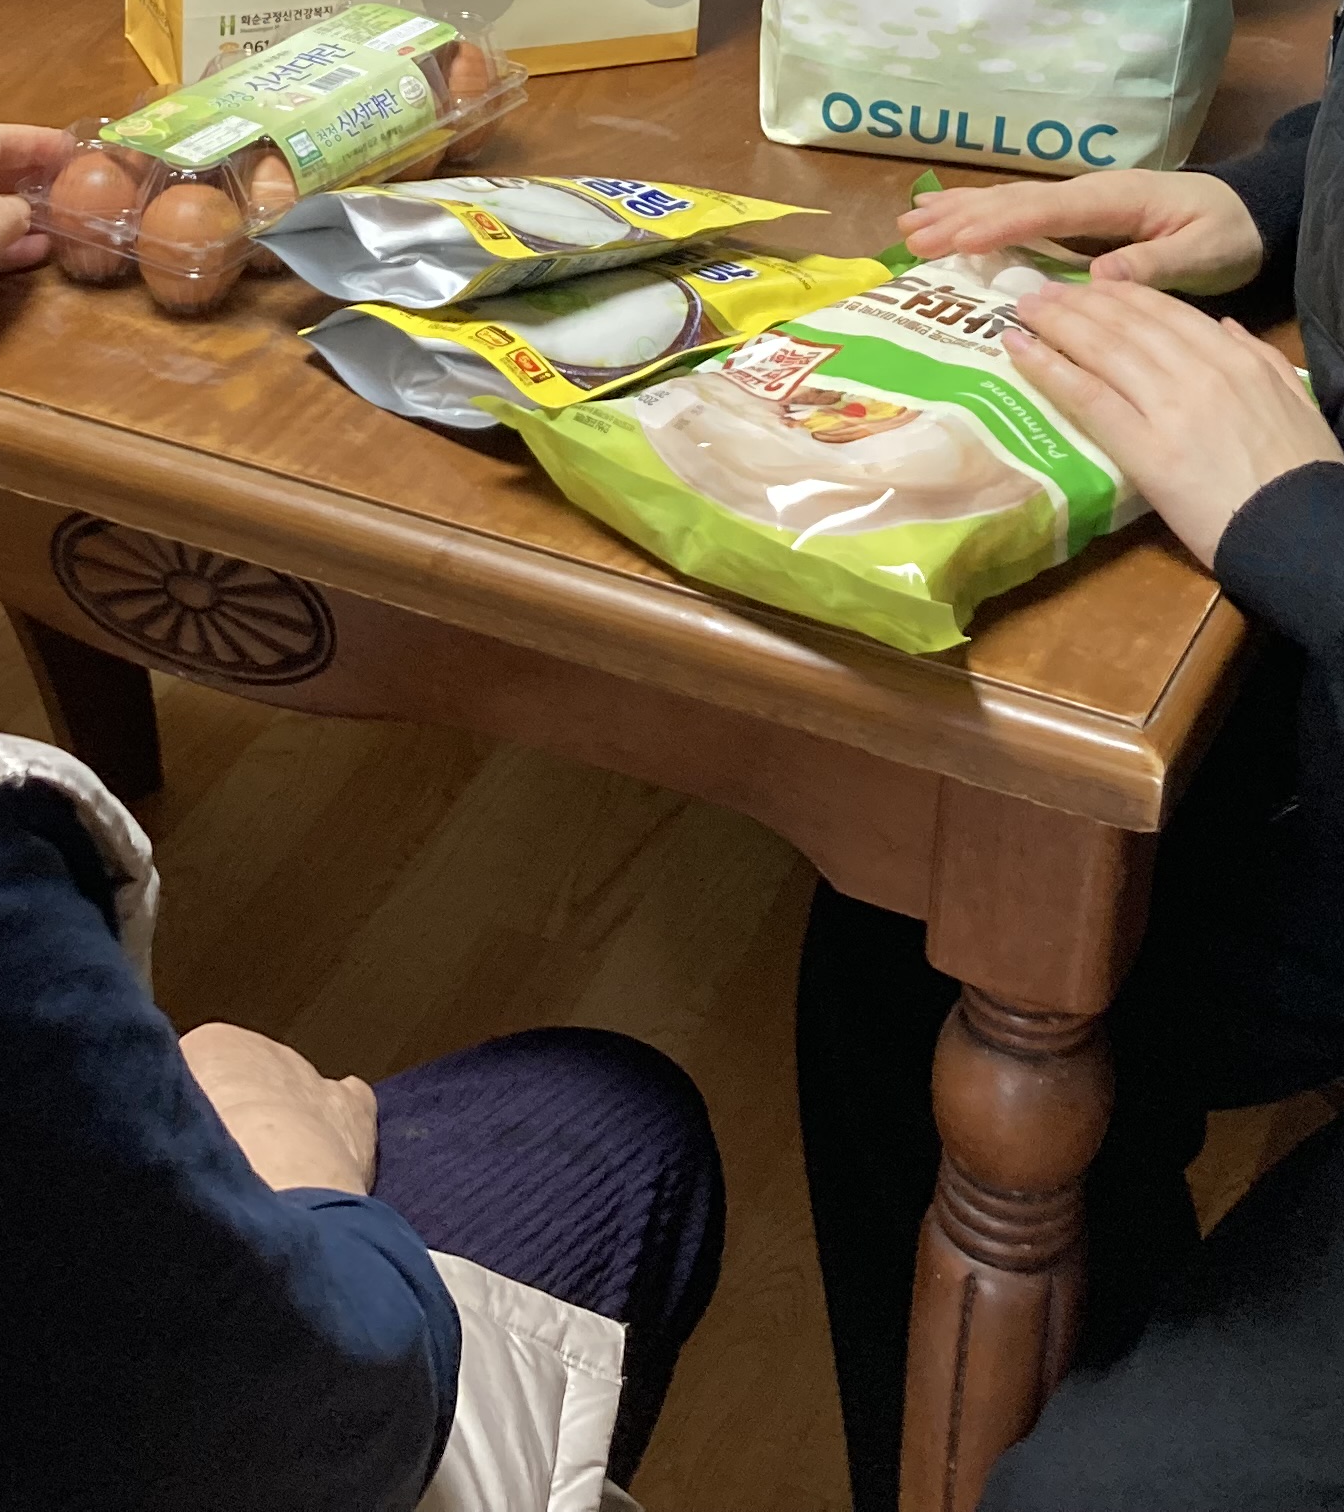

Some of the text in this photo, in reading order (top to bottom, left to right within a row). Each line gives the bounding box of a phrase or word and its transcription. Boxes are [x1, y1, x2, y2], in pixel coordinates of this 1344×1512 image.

[246, 42, 356, 92] 신선대란
[316, 123, 342, 148] 청정
[336, 89, 403, 137] 신선대란
[822, 92, 1119, 167] OSULLOC
[980, 380, 1069, 459] Pulmuone
